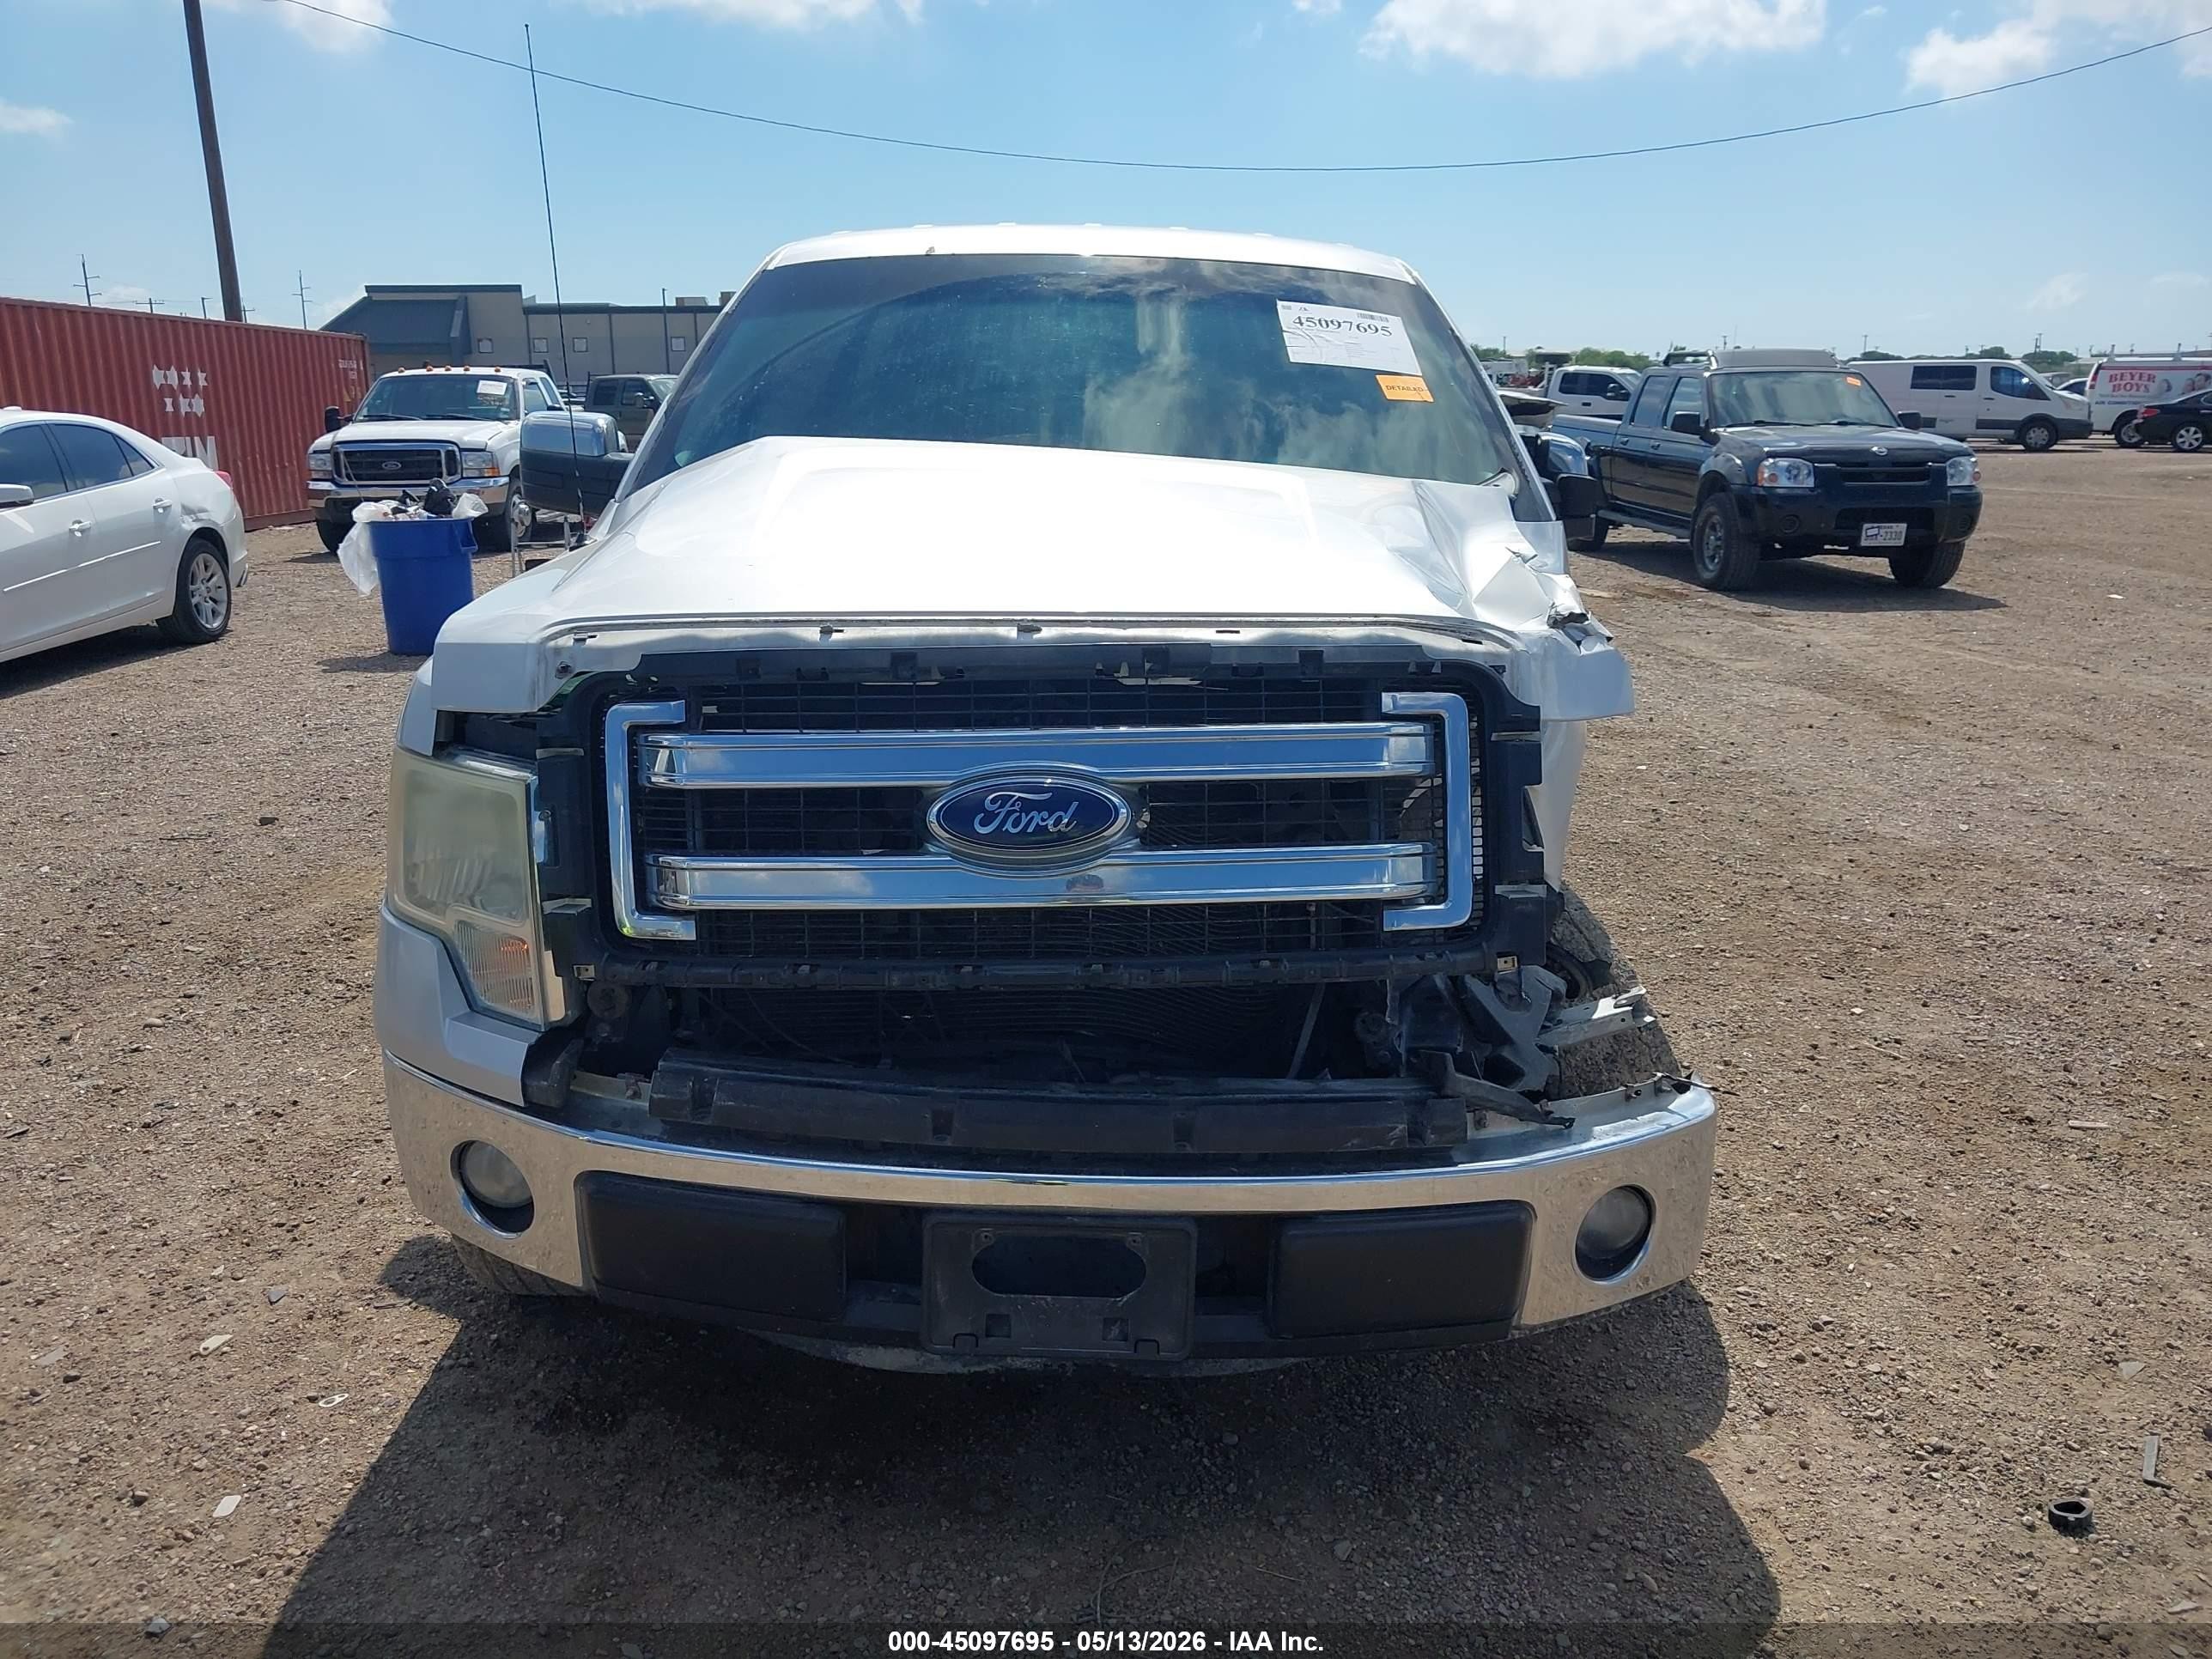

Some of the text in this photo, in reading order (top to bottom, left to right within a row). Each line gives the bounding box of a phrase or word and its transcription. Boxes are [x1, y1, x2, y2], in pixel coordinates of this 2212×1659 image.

[1292, 315, 1393, 337] 45097695
[2109, 372, 2156, 382] BEYER
[2112, 383, 2149, 392] BOYS
[974, 792, 1079, 834] Ford
